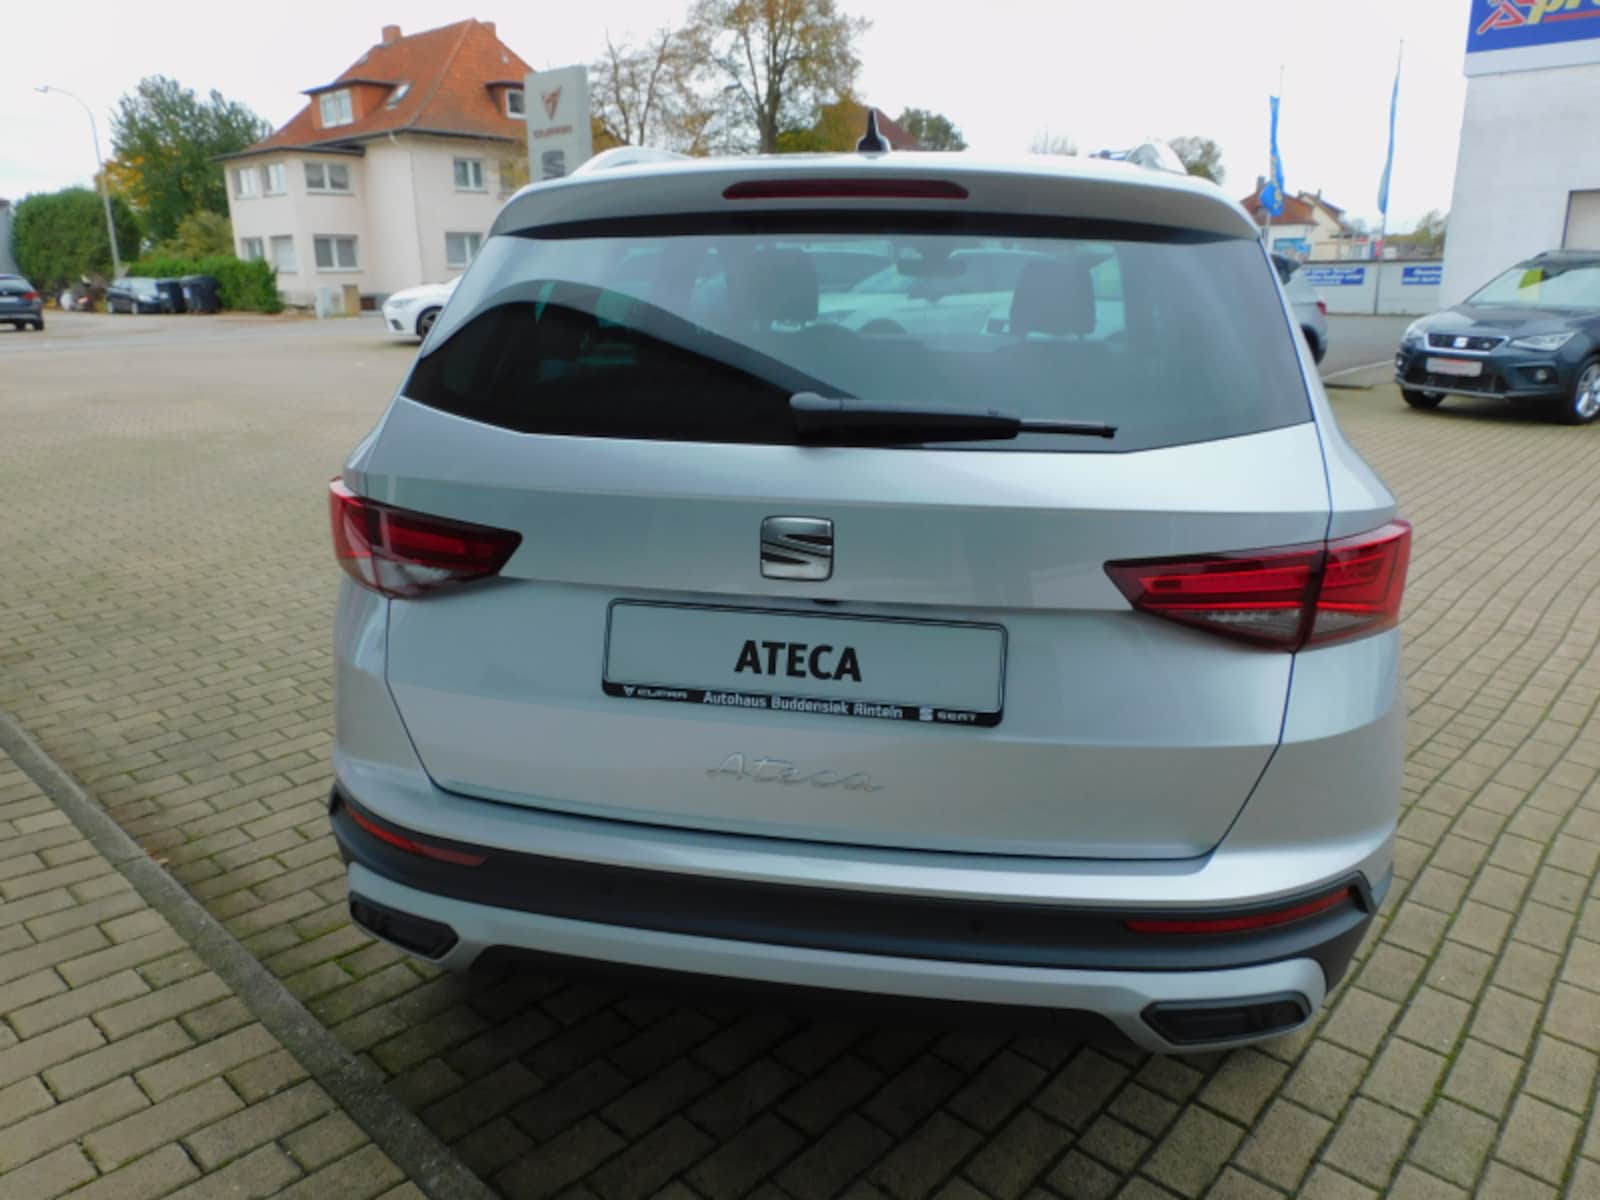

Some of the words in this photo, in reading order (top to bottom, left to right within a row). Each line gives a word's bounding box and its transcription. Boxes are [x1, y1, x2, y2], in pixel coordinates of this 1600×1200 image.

[734, 639, 862, 682] ATECA
[703, 691, 767, 708] Autohaus
[771, 697, 850, 715] Buddensiek
[705, 752, 884, 792] Ateca
